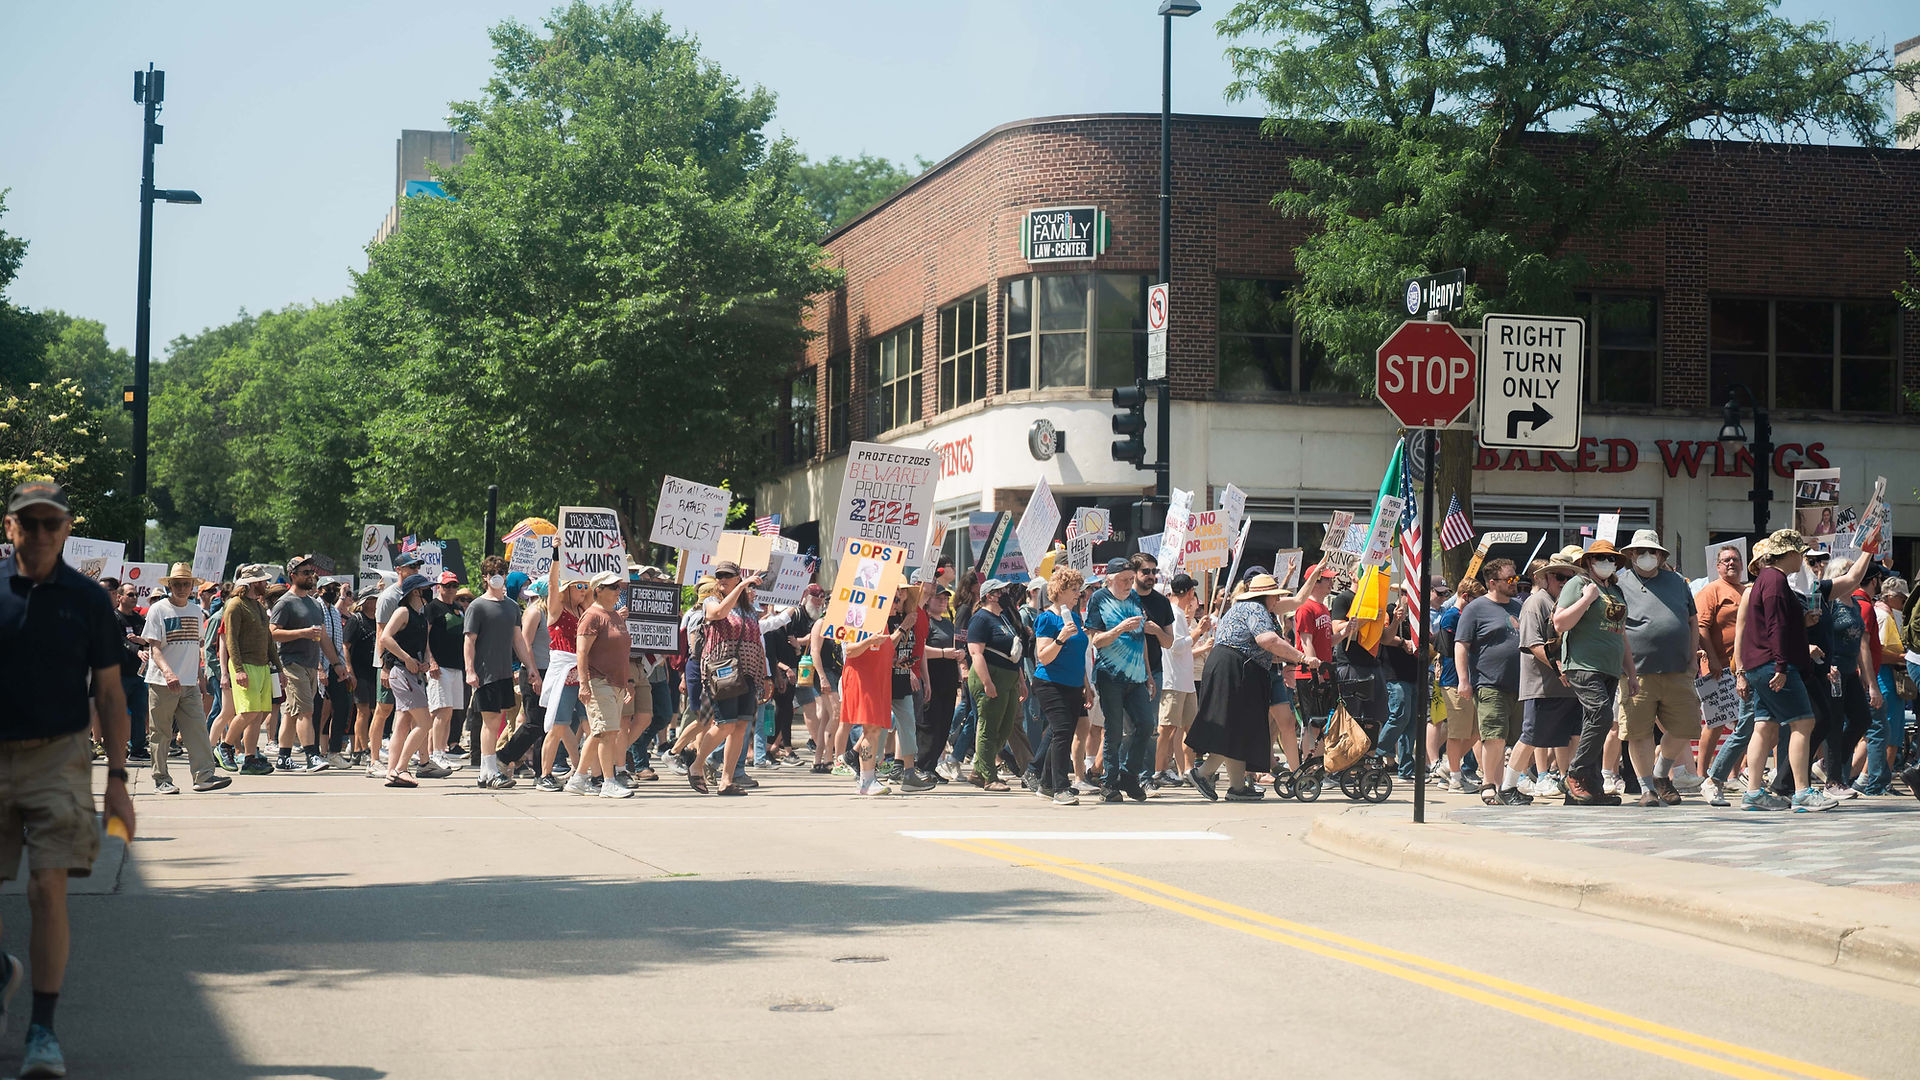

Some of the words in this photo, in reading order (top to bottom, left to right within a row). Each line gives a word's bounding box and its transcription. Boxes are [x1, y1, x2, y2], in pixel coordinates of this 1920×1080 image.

[1033, 213, 1064, 224] YOUR
[1033, 222, 1090, 241] FAMILY
[1429, 280, 1455, 311] Henry
[1456, 281, 1462, 297] St
[1501, 325, 1566, 347] RIGHT
[1503, 351, 1562, 374] TURN
[1385, 354, 1470, 395] STOP
[1503, 377, 1561, 399] ONLY
[1655, 438, 1831, 479] WINGS
[849, 462, 930, 485] BEWARE!
[665, 480, 683, 494] This
[687, 486, 699, 496] all
[854, 480, 916, 502] PROJECT
[677, 499, 707, 516] RATHER
[849, 498, 920, 527] 2026
[1200, 511, 1216, 525] NO
[660, 514, 720, 541] FASCIST
[860, 523, 901, 541] BEGINS
[1194, 524, 1223, 538] KINGS
[200, 532, 225, 555] CLEAN
[564, 530, 586, 548] SAY
[588, 531, 604, 548] NO
[1071, 538, 1088, 553] HELL
[1185, 540, 1200, 554] OR
[1200, 537, 1228, 552] IDIOTS
[71, 541, 94, 557] HATE
[849, 542, 892, 561] OOPS
[362, 554, 383, 562] UPHOLD
[420, 552, 440, 565] SCREW
[585, 553, 621, 574] KINGS
[1011, 560, 1021, 569] ALL
[1071, 553, 1089, 571] CHIEF
[1186, 556, 1221, 573] EITHER
[780, 568, 805, 577] FATHER
[655, 590, 674, 602] MONEY
[776, 583, 800, 592] FOUGHT
[839, 587, 866, 604] DID
[871, 595, 888, 609] IT
[631, 600, 642, 611] FOR
[648, 601, 673, 614] PARADE?
[641, 634, 671, 647] MEDICAID!
[1706, 713, 1727, 726] anyone
